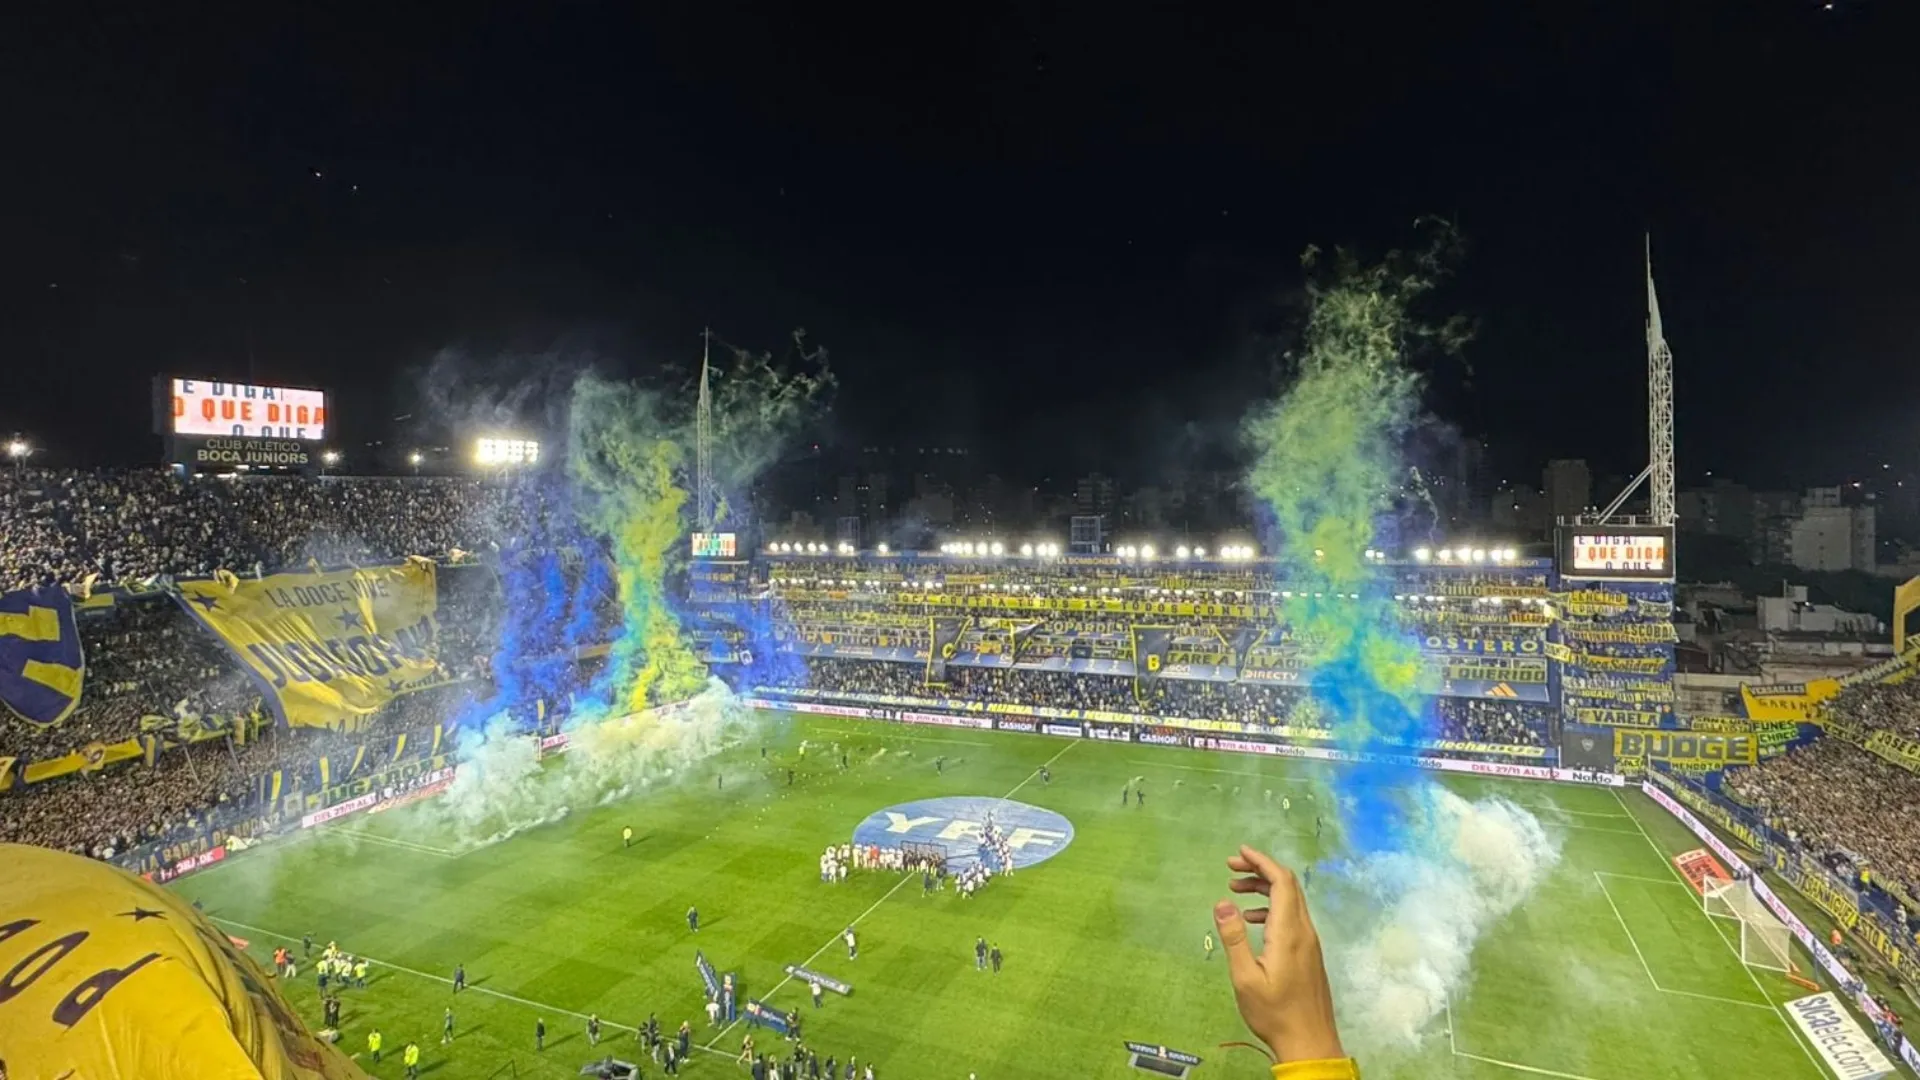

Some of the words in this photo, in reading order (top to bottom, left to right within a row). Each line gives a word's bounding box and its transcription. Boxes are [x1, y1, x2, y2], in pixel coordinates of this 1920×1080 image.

[202, 399, 252, 422] QUE
[268, 403, 324, 424] DIGA
[206, 438, 242, 450] CLUB
[197, 450, 241, 462] BOCA
[245, 451, 308, 464] JUNIORS
[1589, 547, 1617, 561] QUE
[1626, 547, 1667, 559] DIGA
[264, 587, 296, 609] LA
[294, 582, 348, 608] DOCE
[940, 596, 1006, 607] CONTRA
[1121, 601, 1178, 613] TODOS
[1245, 669, 1298, 681] DIRECTV
[1593, 709, 1658, 726] VARELA
[1754, 719, 1796, 732] FUNES
[1620, 732, 1750, 761] BUDGE
[1878, 732, 1906, 753] JOSE
[1275, 746, 1305, 757] Naldo
[1410, 756, 1442, 769] Naldo
[1471, 763, 1494, 773] DEL
[1495, 766, 1521, 776] 27/11
[1523, 768, 1538, 777] AL
[885, 811, 1066, 849] YPF
